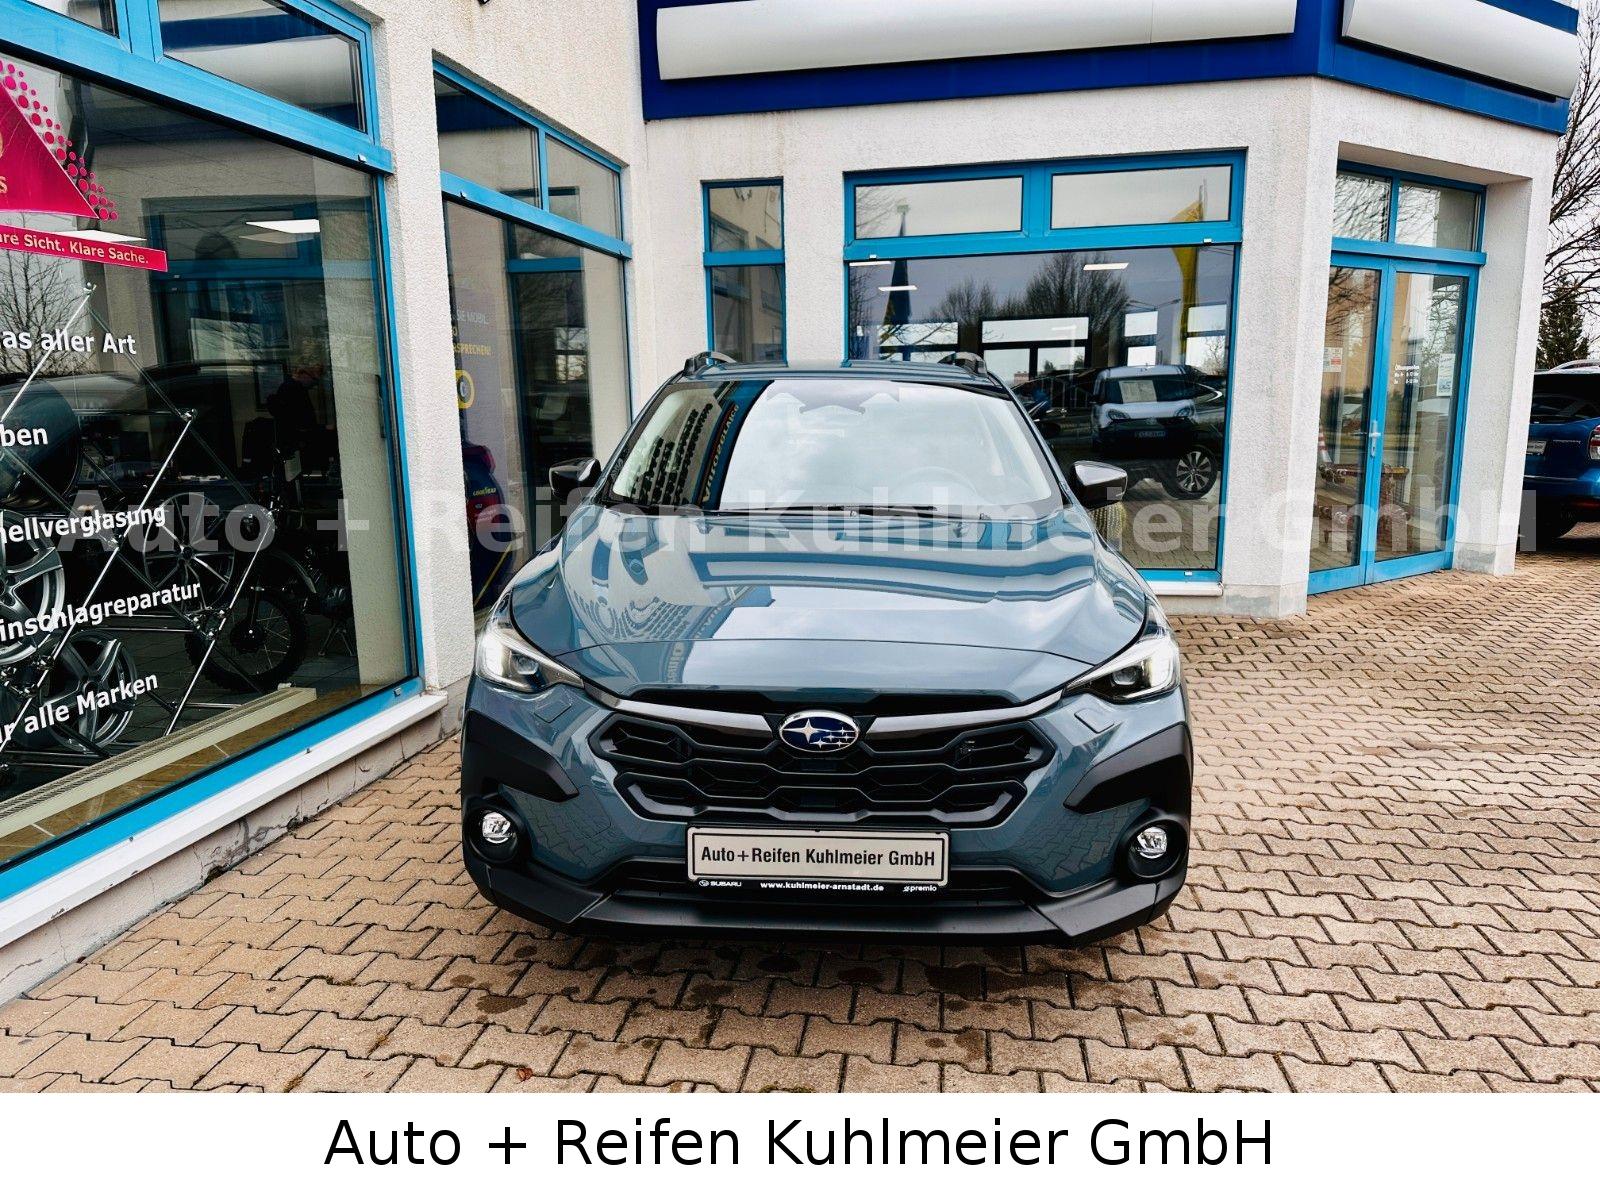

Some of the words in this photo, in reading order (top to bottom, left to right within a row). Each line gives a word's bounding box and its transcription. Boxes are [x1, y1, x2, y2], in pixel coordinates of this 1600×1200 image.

[0, 233, 20, 246] re
[24, 234, 65, 253] Sicht.
[70, 241, 105, 259] Klare
[108, 248, 149, 264] Sache.
[2, 330, 32, 350] as
[41, 328, 95, 353] aller
[102, 332, 137, 355] Art
[0, 423, 49, 447] ben
[0, 582, 201, 641] inschlagreparatur
[24, 703, 70, 734] alle
[76, 674, 158, 715] Marken
[806, 849, 884, 865] Kuhlmeier
[889, 850, 935, 866] GmbH
[760, 882, 885, 892] www.kuhlmeier-arnstadt.de
[910, 885, 938, 893] premio
